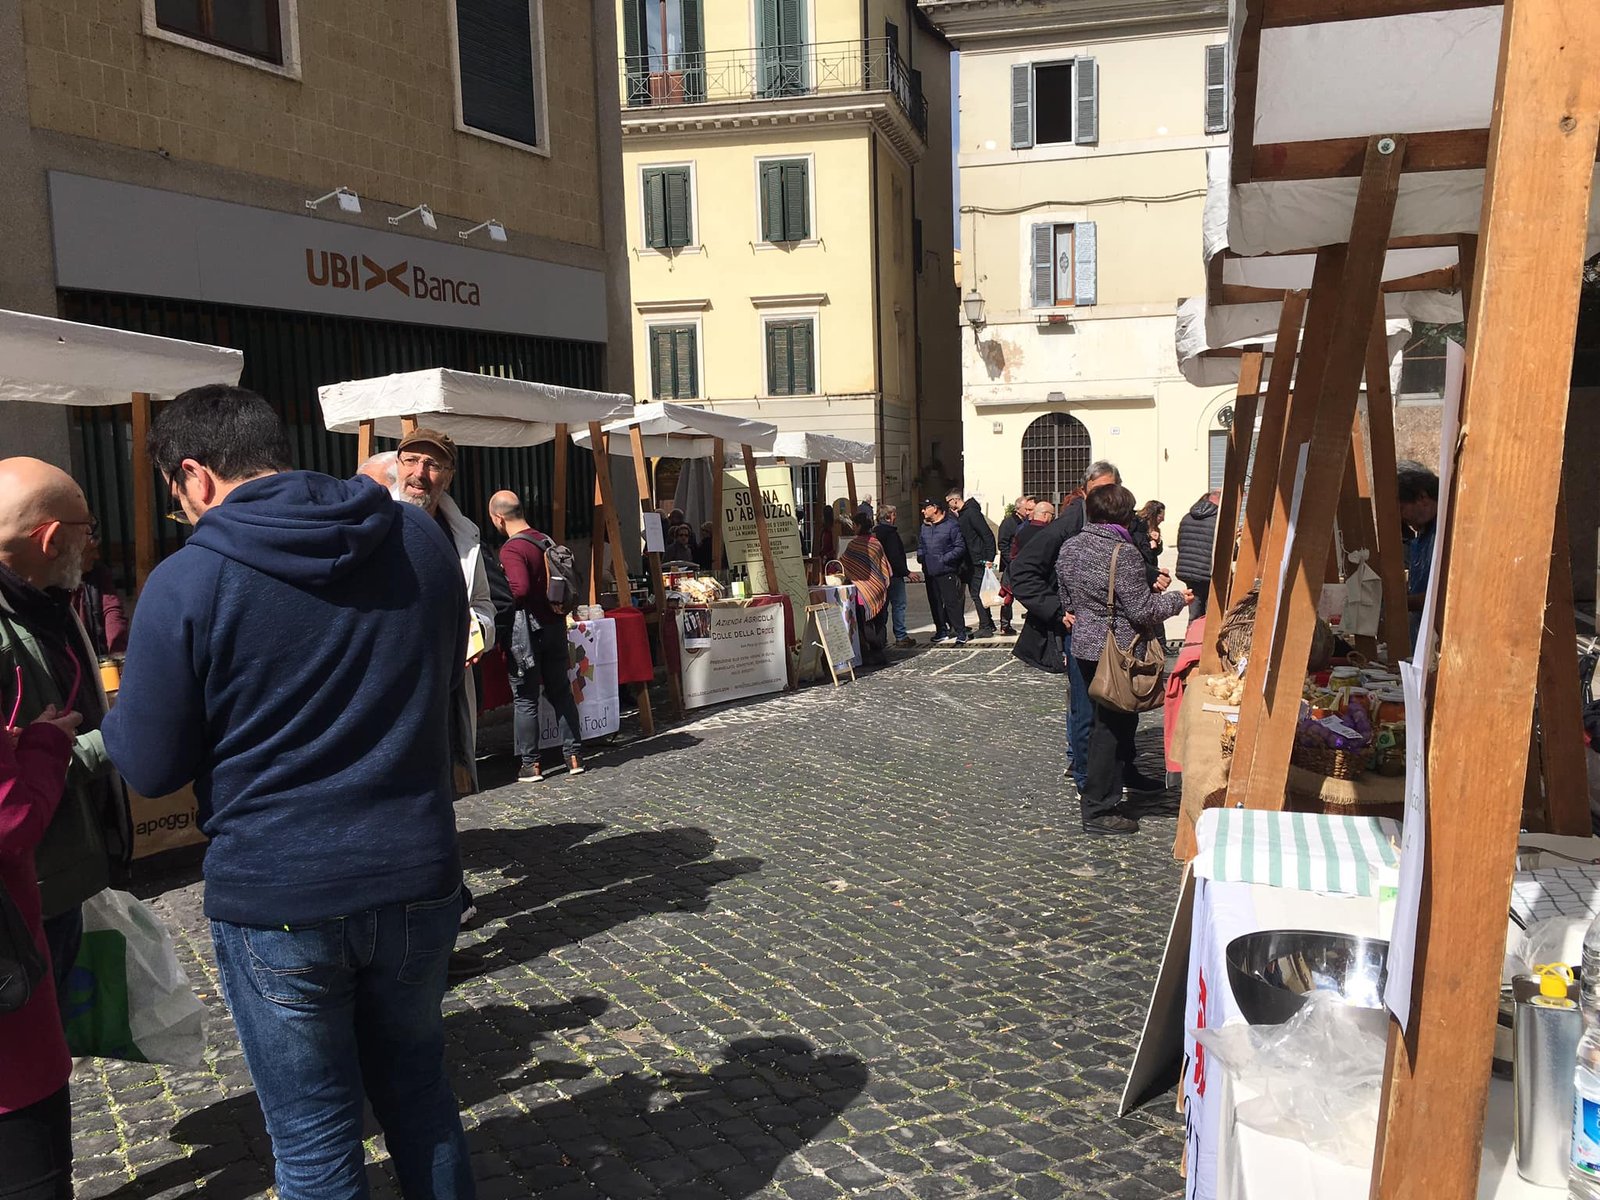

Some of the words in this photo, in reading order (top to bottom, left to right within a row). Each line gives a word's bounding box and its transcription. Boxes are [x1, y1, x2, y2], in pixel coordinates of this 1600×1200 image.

[306, 248, 360, 291] UBI
[413, 266, 481, 307] Banca
[735, 489, 779, 506] SONA
[725, 503, 792, 522] D'ABUZZO
[715, 618, 742, 627] AZIENDA
[743, 614, 774, 624] AGRICOLA
[712, 631, 732, 640] COLLE
[734, 629, 754, 638] DELLA
[584, 706, 608, 731] Food
[136, 807, 199, 836] apoggi
